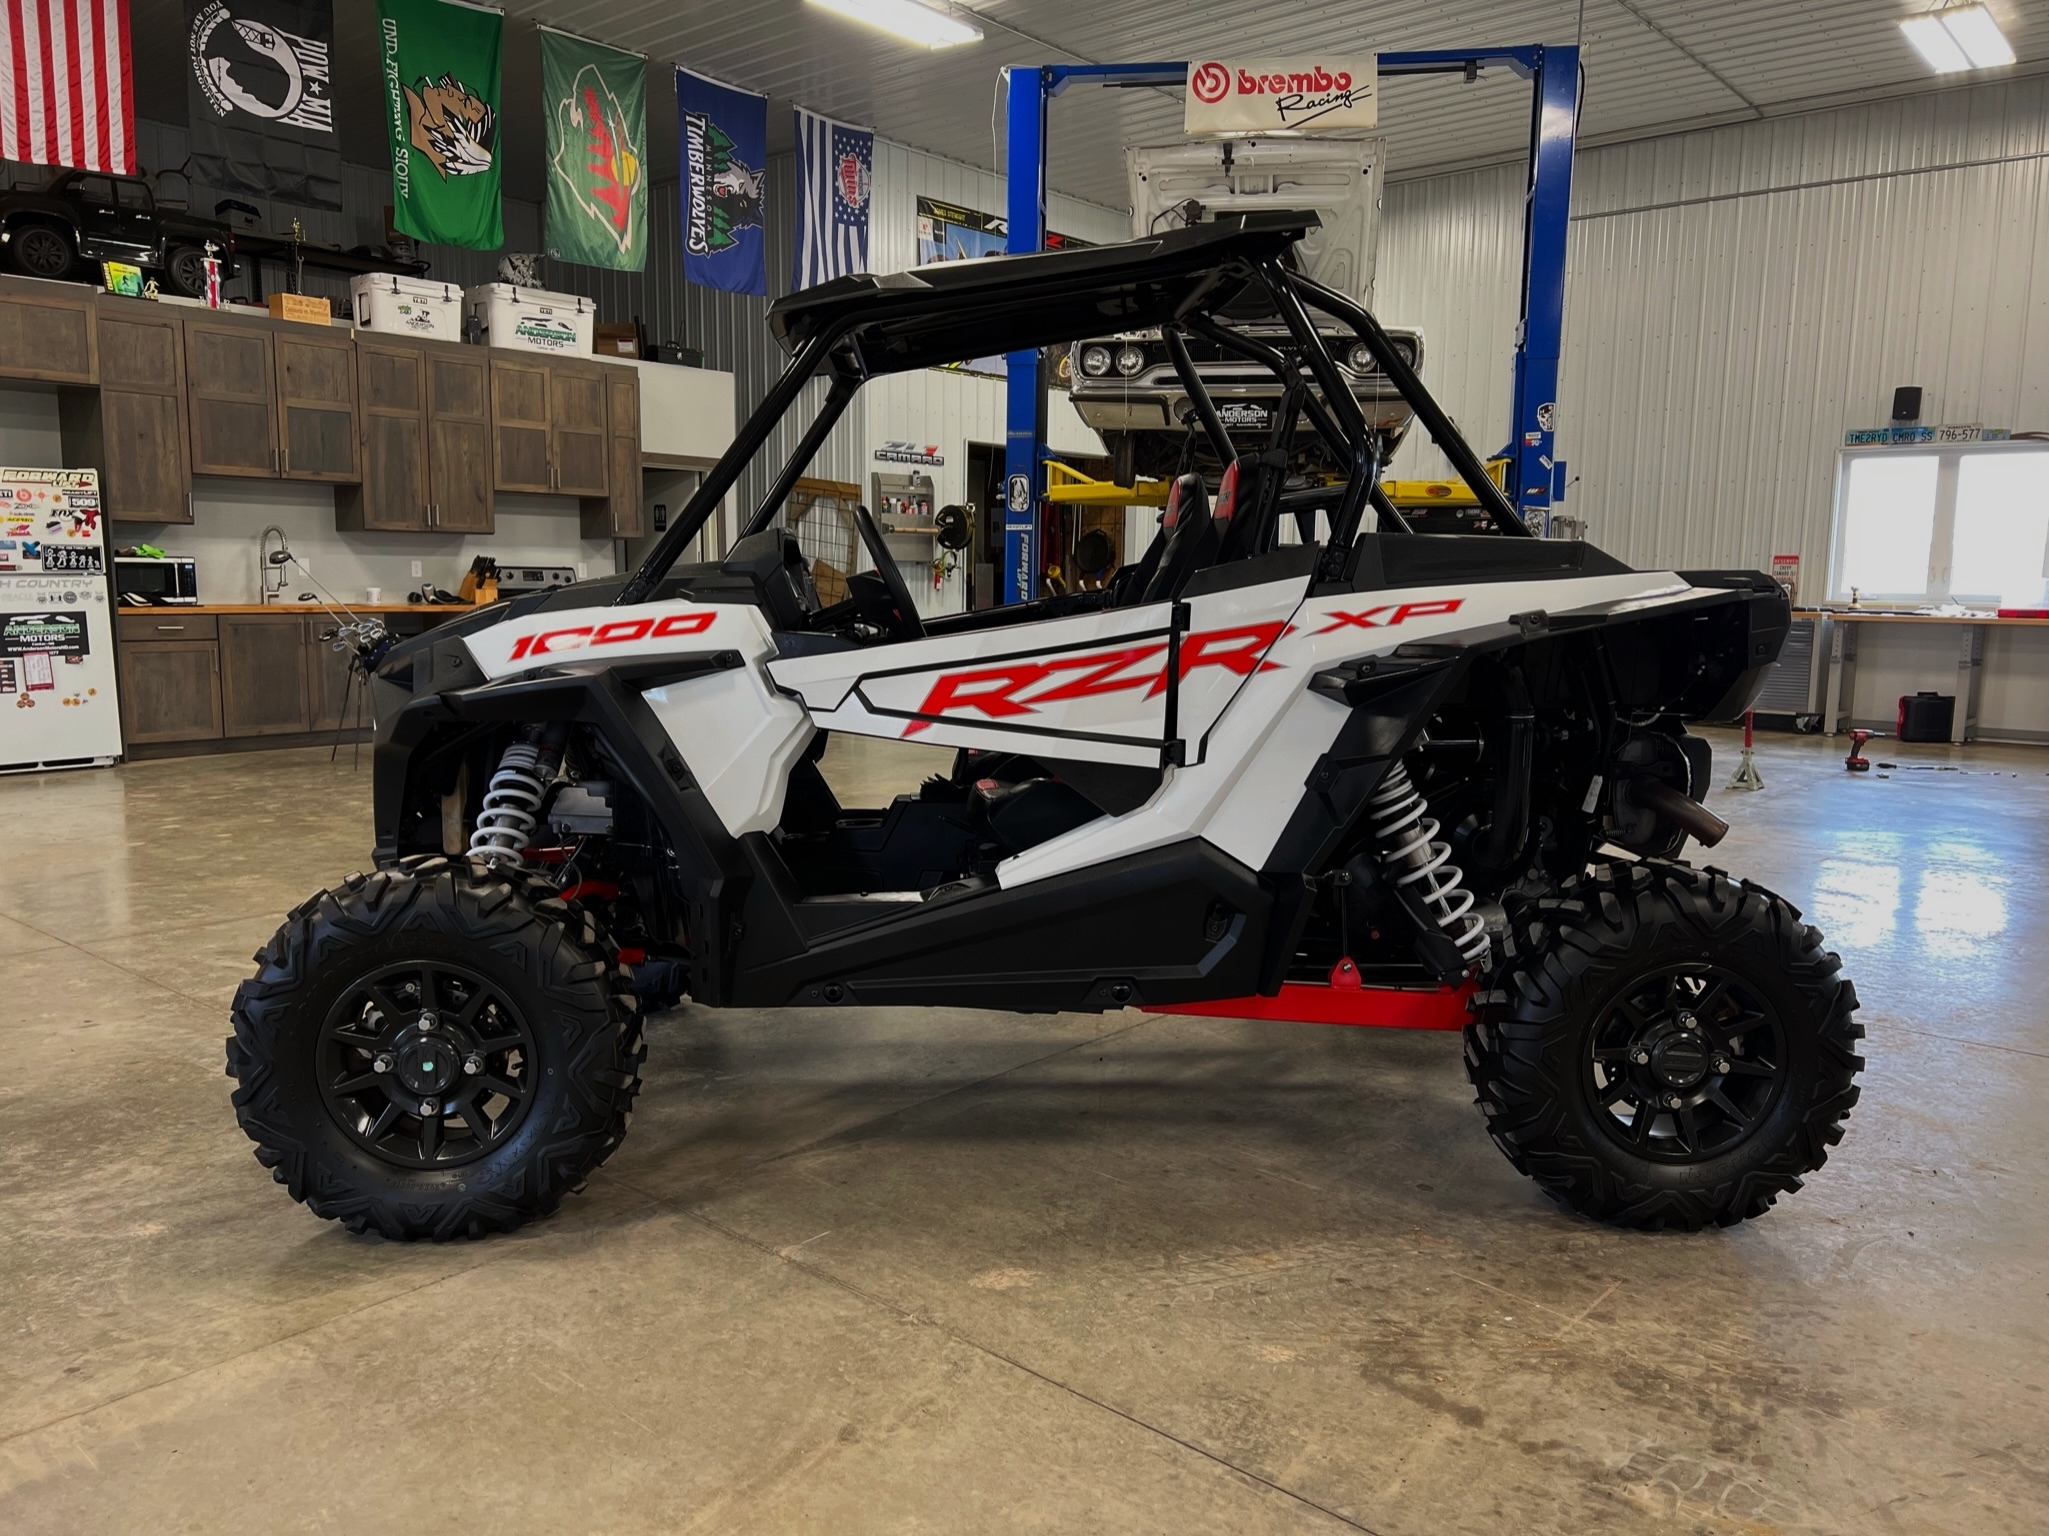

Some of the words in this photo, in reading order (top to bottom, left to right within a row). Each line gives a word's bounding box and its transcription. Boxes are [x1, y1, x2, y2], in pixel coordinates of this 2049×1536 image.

[203, 0, 224, 16] YOU
[192, 13, 204, 35] ARE
[189, 34, 197, 54] NOT
[272, 26, 329, 84] POW
[1238, 66, 1351, 94] brembo
[275, 93, 333, 133] MIA
[1275, 89, 1354, 122] Racing
[685, 114, 708, 257] TIMBERWOLVES
[528, 336, 564, 348] MOTORS
[1215, 409, 1268, 418] ANDERSON
[1940, 428, 1981, 441] 796-577
[875, 450, 945, 466] CAMARO
[2, 469, 96, 483] FORWARD
[1020, 532, 1030, 601] FORWARD
[16, 579, 93, 588] COUNTRY
[20, 634, 66, 642] MOTORS
[507, 611, 718, 662] 1000
[902, 620, 1299, 738] RZR
[1303, 598, 1467, 638] XP
